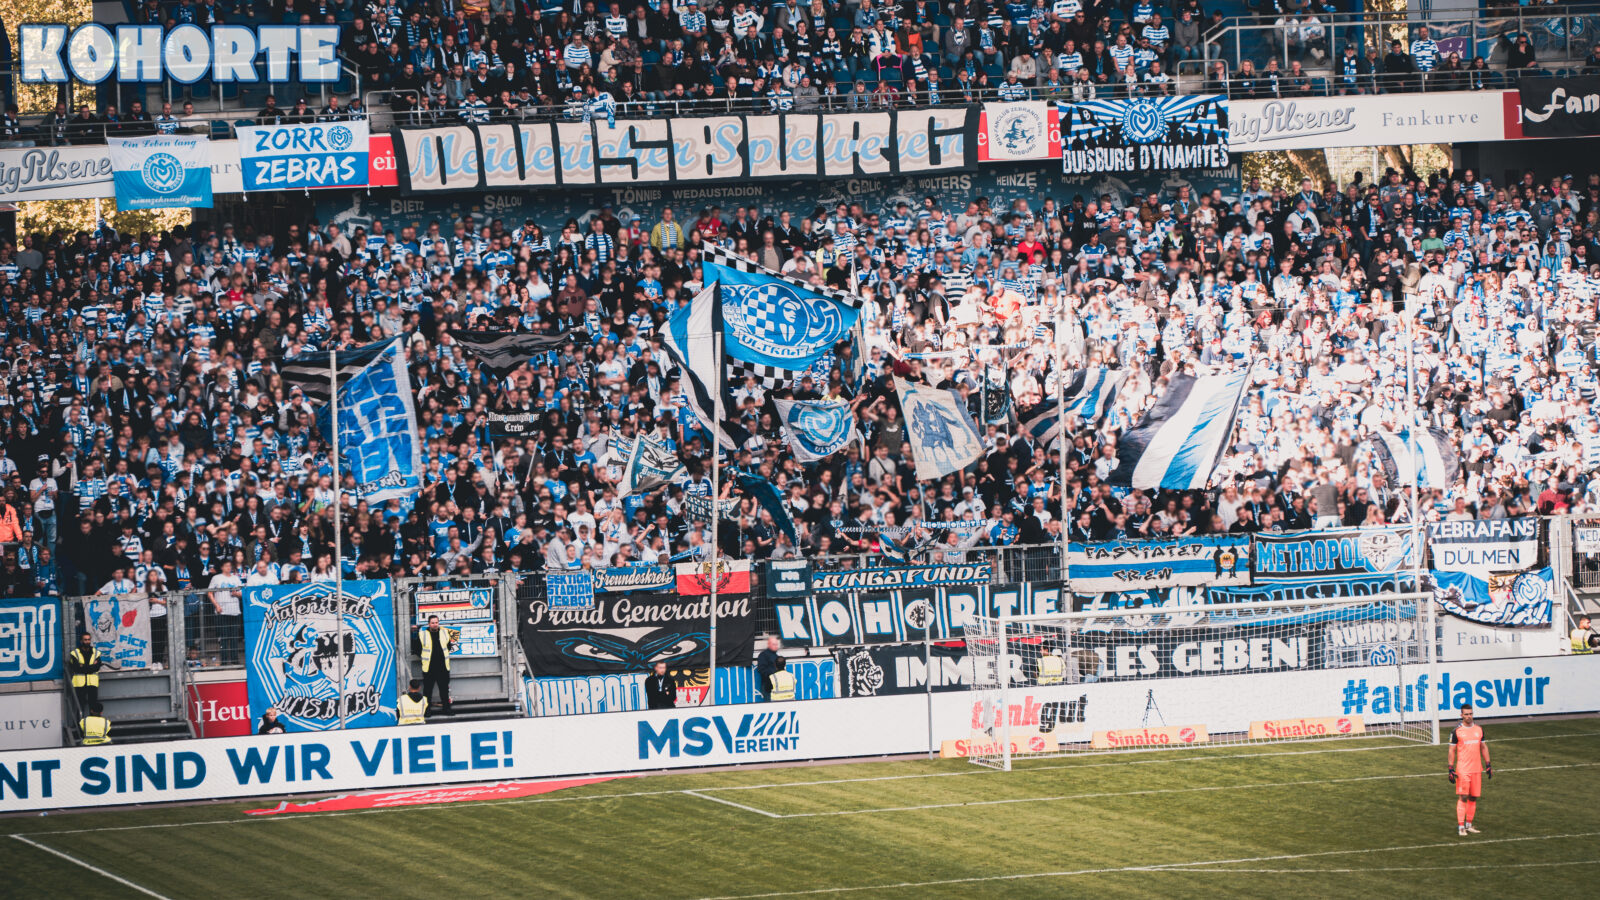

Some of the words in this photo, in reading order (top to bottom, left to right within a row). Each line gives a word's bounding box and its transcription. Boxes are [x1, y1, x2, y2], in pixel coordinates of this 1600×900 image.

[1260, 100, 1356, 134] Pilsener
[1382, 111, 1480, 128] Fankurve
[20, 149, 113, 184] Pilsene
[1062, 147, 1135, 174] DUISBURG
[1139, 143, 1229, 171] DYNAMITES
[255, 155, 357, 185] ZEBRAS
[996, 171, 1038, 187] HEINZE
[918, 174, 972, 191] WOLTERS
[611, 186, 662, 206] TÖNNIES
[672, 186, 763, 200] WEDAUSTADION
[391, 199, 424, 215] DIETZ
[484, 194, 523, 211] SALOU
[1430, 519, 1535, 539] ZEBRAFANS
[1444, 547, 1520, 565] DÜLMEN
[547, 573, 592, 585] SEKTION
[595, 568, 674, 589] Freundeskreis
[1112, 566, 1173, 582] CREW
[417, 590, 470, 603] SEKTION
[547, 584, 592, 596] STADION
[548, 595, 594, 609] VERBOT
[418, 608, 490, 622] LKSRHEIN
[611, 596, 752, 627] Generaton
[894, 653, 1029, 689] IMMER
[1171, 637, 1307, 673] GEBEN!
[1106, 729, 1170, 747] Sinalco
[1263, 720, 1327, 739] Sinalco
[80, 751, 207, 795] SIND
[225, 744, 335, 785] WIR
[349, 730, 515, 777] VIELE!
